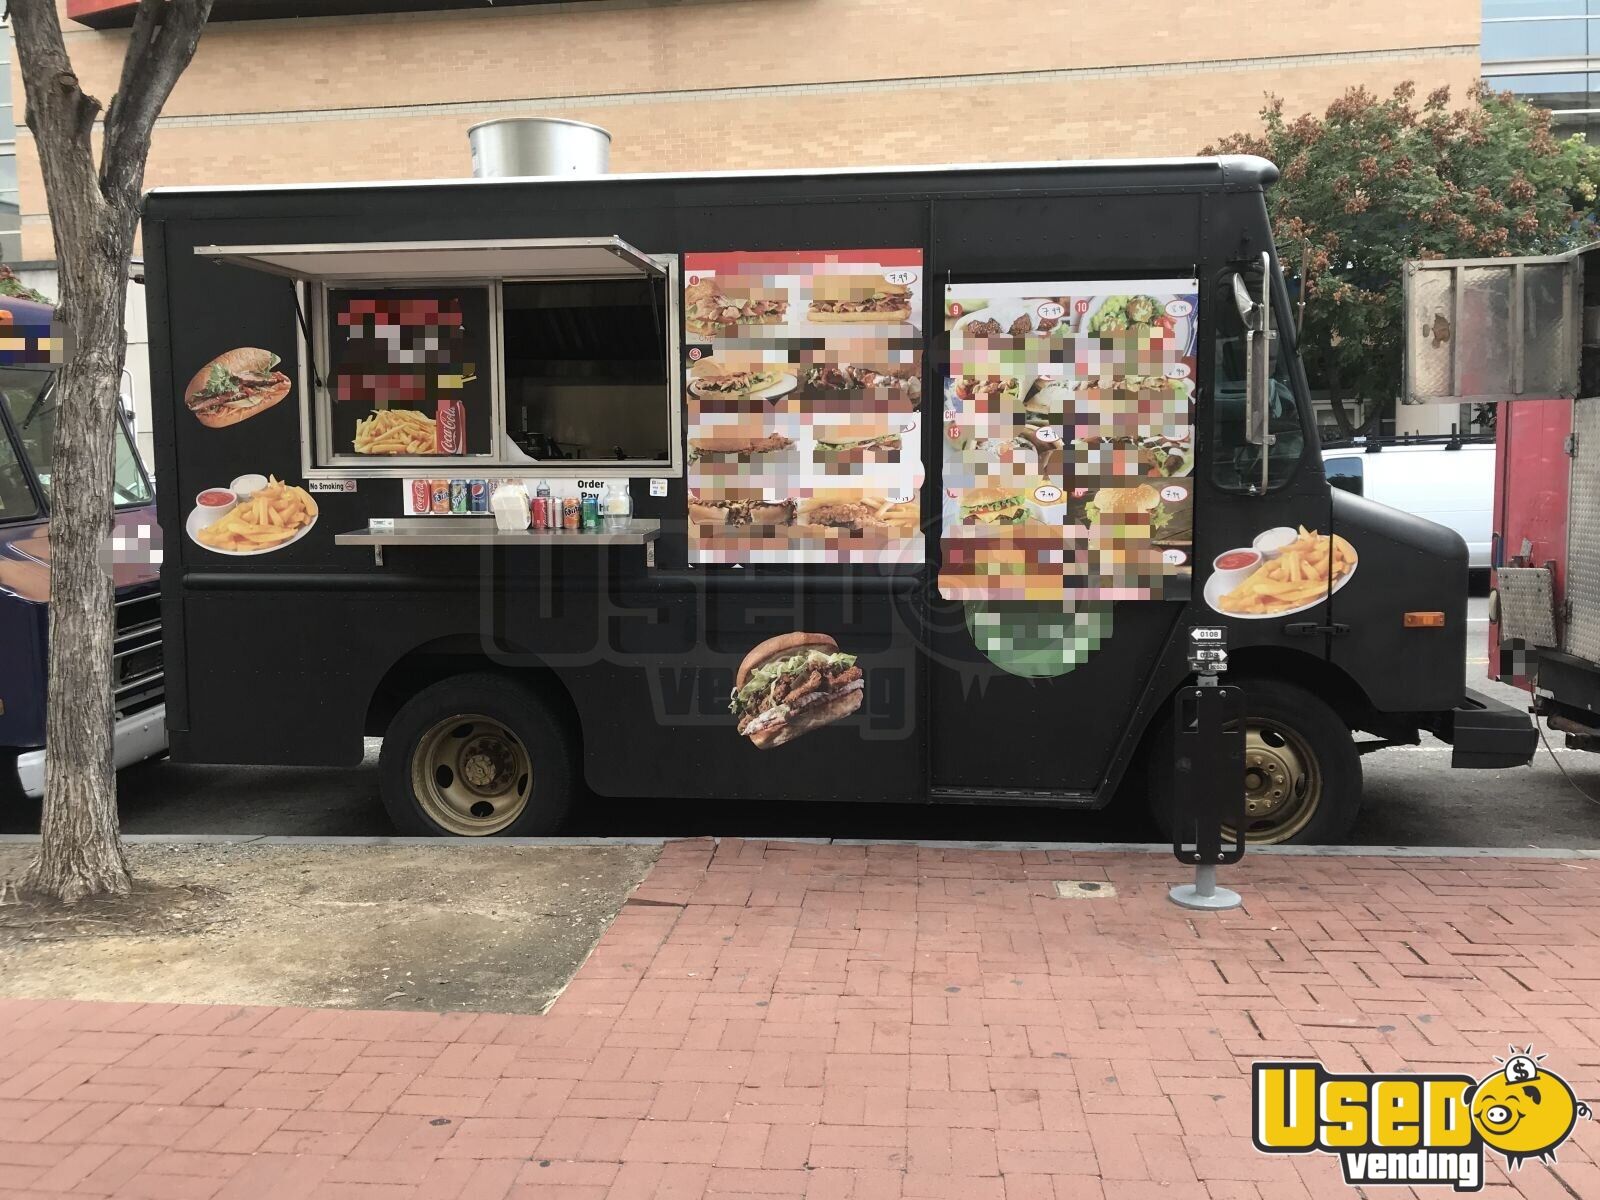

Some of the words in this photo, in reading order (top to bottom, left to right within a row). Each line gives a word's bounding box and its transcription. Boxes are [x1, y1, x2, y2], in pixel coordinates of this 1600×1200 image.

[953, 304, 959, 312] 9
[1077, 302, 1087, 313] 10
[949, 427, 959, 437] 13
[310, 480, 318, 490] No
[319, 480, 344, 492] Smoking
[577, 479, 604, 489] Order
